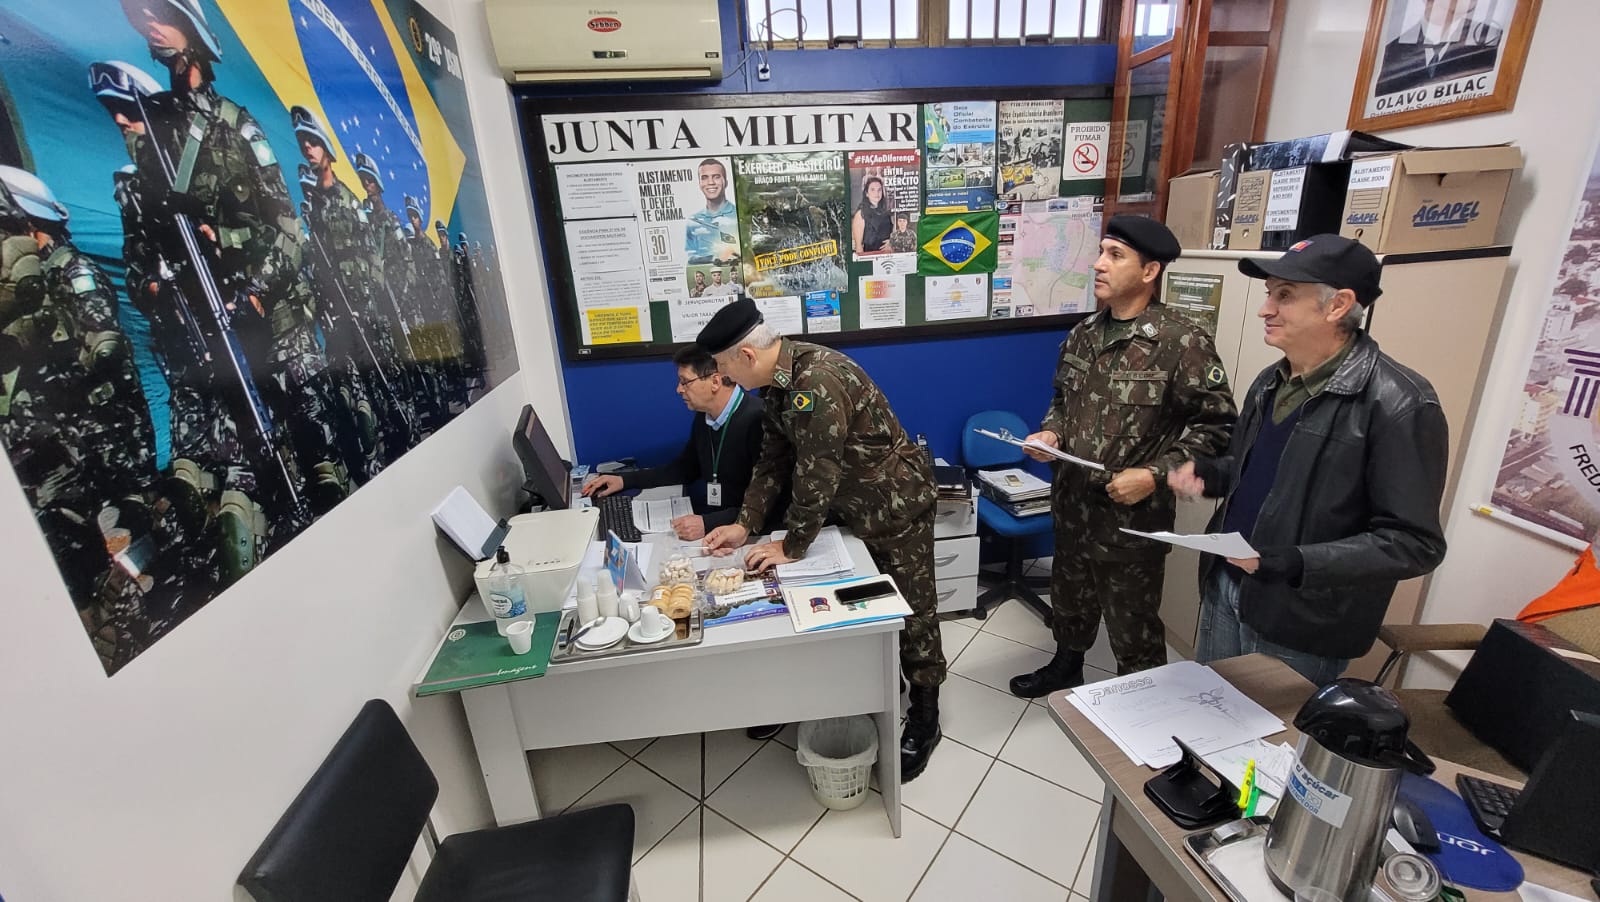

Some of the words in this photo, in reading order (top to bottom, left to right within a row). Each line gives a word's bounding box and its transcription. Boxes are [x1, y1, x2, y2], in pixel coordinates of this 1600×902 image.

[1376, 89, 1428, 111] OLAVO
[1433, 75, 1488, 99] BILAC
[549, 117, 701, 155] JUNTA
[722, 111, 916, 148] MILITAR
[1070, 125, 1106, 133] PROIBIDO
[1074, 134, 1101, 142] FUMAR
[883, 166, 904, 176] ENTRE
[1354, 165, 1391, 174] ALISTAMENTO
[638, 168, 693, 185] ALISTAMENTO
[774, 175, 791, 184] FORTE
[884, 175, 919, 187] EXÉRCITO
[1351, 175, 1371, 184] CLASSE
[1371, 174, 1385, 182] 2004
[639, 183, 675, 198] MILITAR.
[640, 198, 647, 210] O
[649, 196, 676, 210] DEVER
[642, 210, 651, 223] TE
[654, 207, 686, 221] CHAMA.
[1346, 212, 1380, 222] AGAPEL
[1411, 200, 1480, 223] AGAPEL
[651, 234, 667, 256] 30
[779, 251, 798, 263] PODE
[1301, 771, 1340, 801] açúcar
